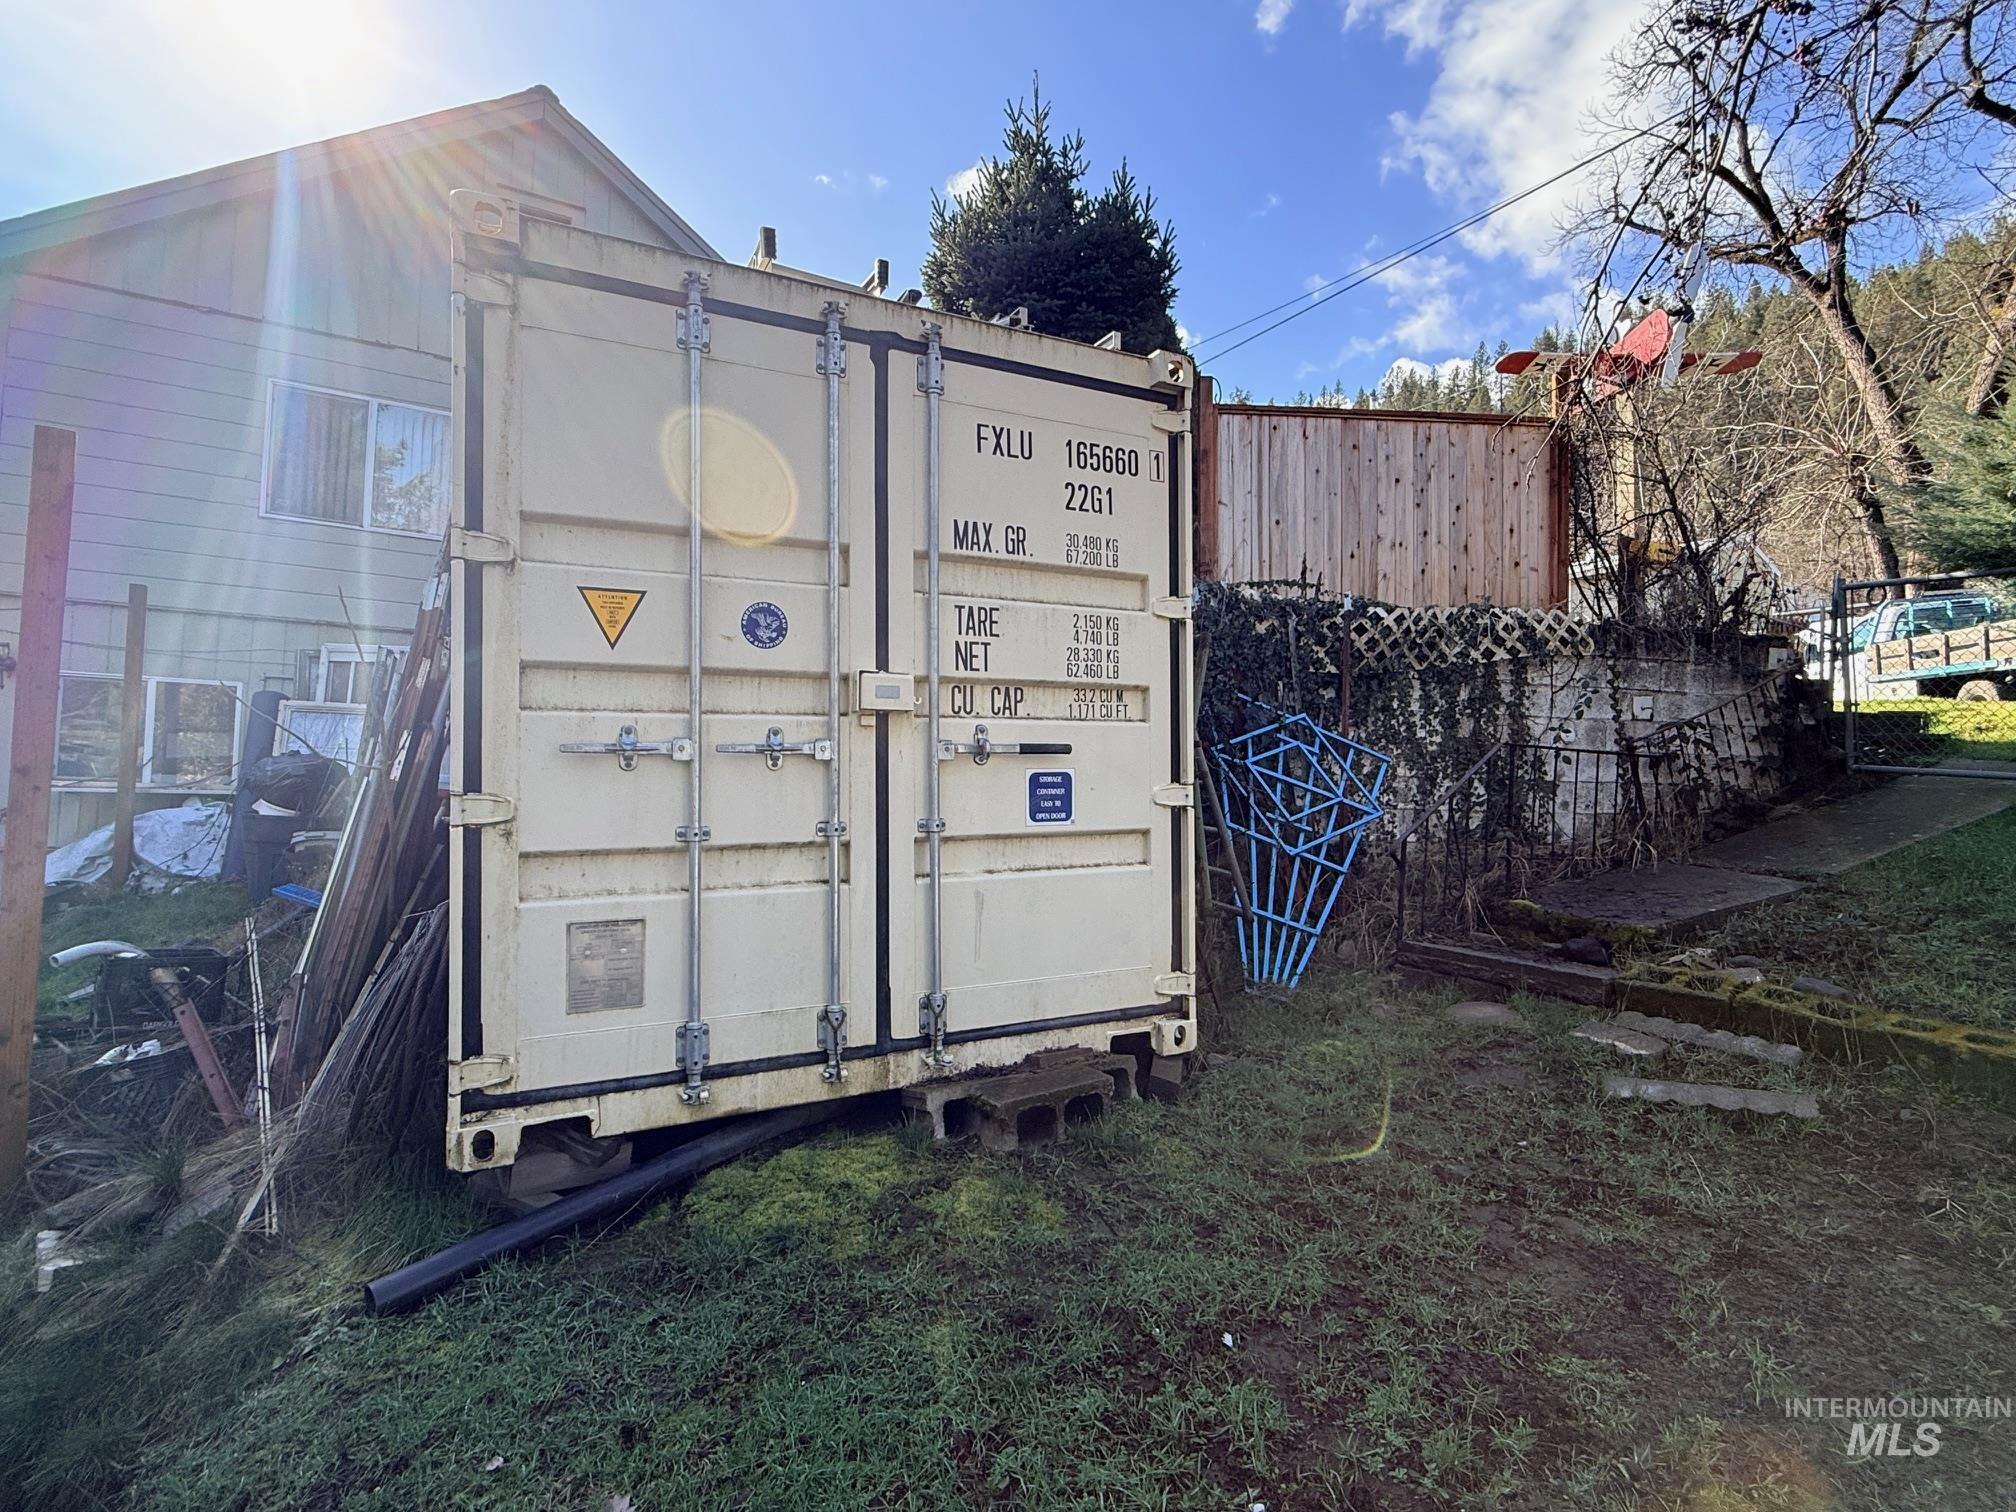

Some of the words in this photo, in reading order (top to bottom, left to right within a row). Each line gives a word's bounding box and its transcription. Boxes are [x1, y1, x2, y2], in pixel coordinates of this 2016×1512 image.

[976, 422, 1033, 461] FXLU
[1065, 438, 1139, 477] 165660
[1064, 481, 1113, 516] 22G1
[953, 518, 999, 554] MAX.
[1004, 524, 1034, 558] GR.
[1065, 532, 1102, 552] 30.480
[1105, 537, 1119, 554] KG
[1066, 548, 1102, 567] 67.200
[1105, 552, 1119, 569] LB
[742, 603, 768, 625] AMERICAN
[954, 604, 1001, 638] TARE
[1072, 613, 1102, 631] 2.150
[1106, 615, 1120, 632] KG
[1073, 629, 1102, 646] 4.740
[1106, 630, 1119, 647] LB
[954, 640, 992, 673] NET
[1066, 646, 1102, 664] 28.330
[1106, 649, 1120, 665] KG
[1066, 662, 1103, 679] 62.460
[1106, 664, 1119, 680] LB
[951, 684, 980, 716] CU.
[990, 685, 1031, 717] CAP.
[1068, 703, 1096, 719] 1.171
[1035, 812, 1050, 820] OPEN
